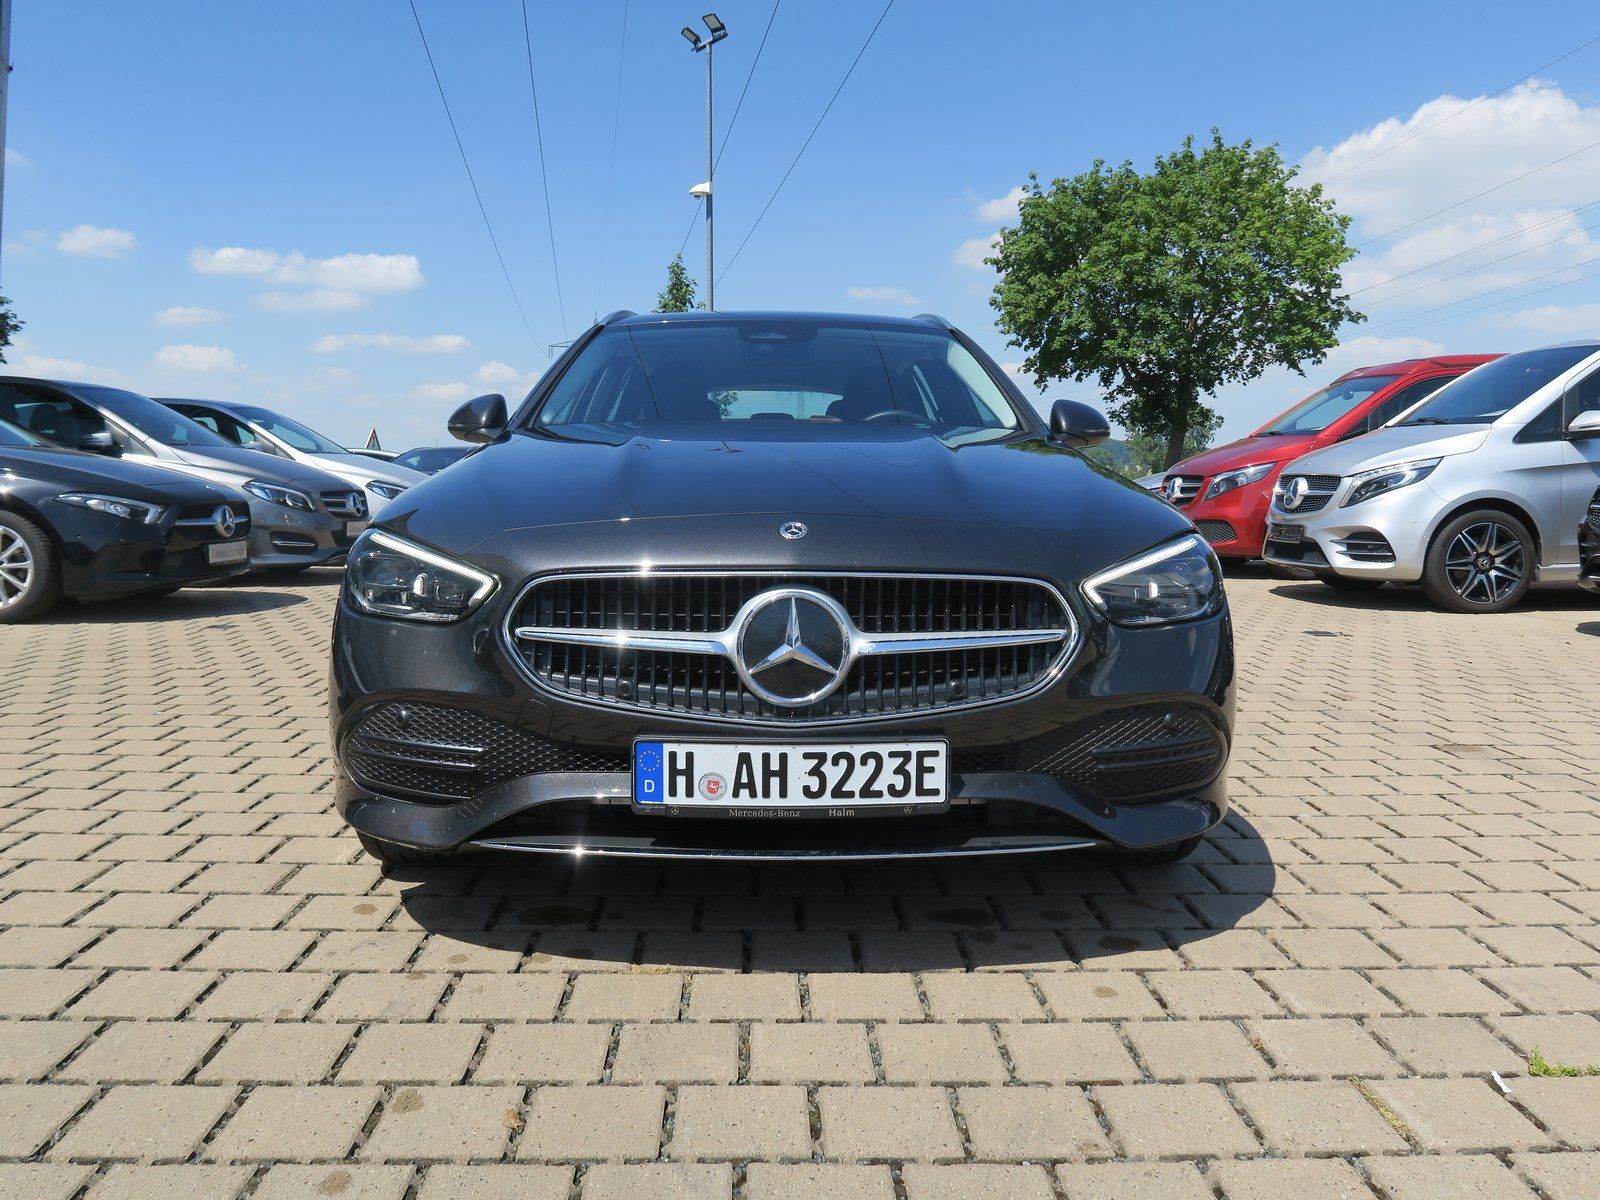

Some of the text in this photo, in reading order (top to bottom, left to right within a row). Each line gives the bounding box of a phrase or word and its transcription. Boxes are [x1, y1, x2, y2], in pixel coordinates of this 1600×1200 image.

[668, 751, 694, 798] H
[732, 751, 788, 799] AH
[802, 750, 940, 799] 3223E
[644, 779, 655, 793] D
[729, 808, 855, 818] Mercedes-Benz Halm
